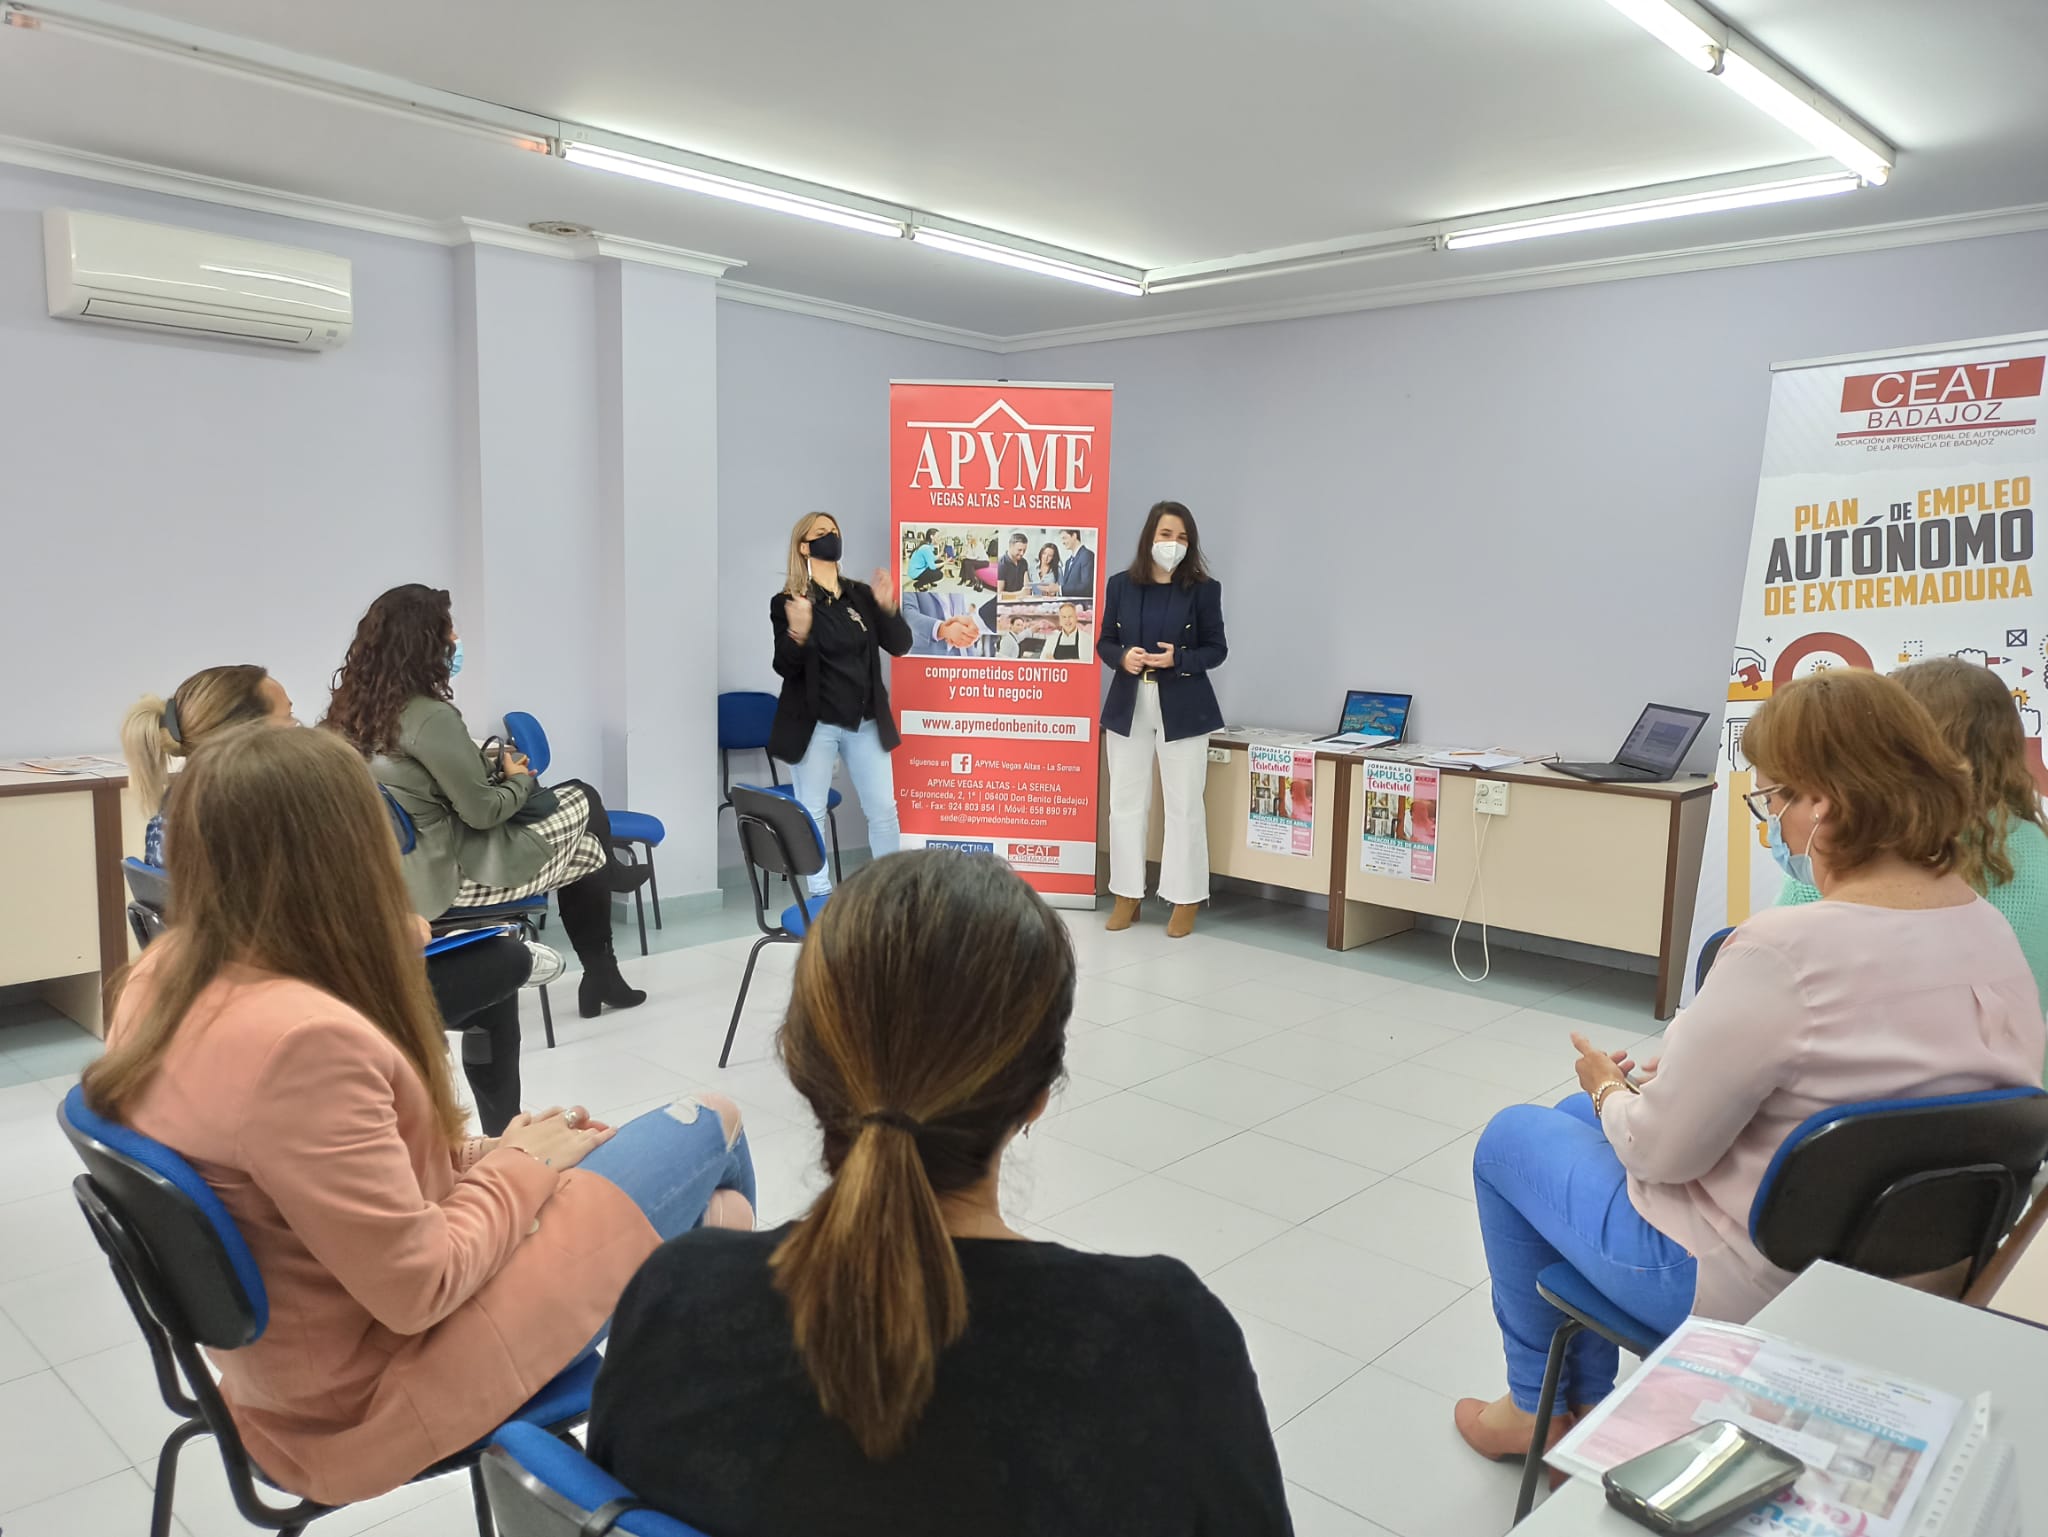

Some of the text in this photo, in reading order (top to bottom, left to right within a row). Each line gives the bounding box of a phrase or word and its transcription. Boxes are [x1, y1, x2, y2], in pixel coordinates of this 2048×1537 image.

[1871, 361, 2010, 408] CEAT
[1867, 401, 2003, 430] BADAJOZ
[1866, 437, 1996, 452] DE LA PROVINCIA DE BADAJOZ
[1958, 431, 1970, 440] DE
[909, 429, 1094, 494] APYME
[930, 491, 964, 508] VEGAS
[967, 492, 1000, 508] ALTAS
[1013, 494, 1026, 509] LA
[1029, 495, 1072, 510] SERENA
[1794, 475, 2031, 532] PLAN DE EMPLEO
[1764, 508, 2034, 585] AUTÓNOMO
[1764, 564, 2033, 617] DE EXTREMADURA
[925, 665, 1068, 683] comprometidos CONTIGO
[949, 683, 1043, 702] y con tu negocio
[921, 716, 1077, 736] www.apymedonbenito.com
[975, 759, 999, 769] APYME
[1001, 760, 1022, 771] Vegas
[1023, 761, 1041, 771] Altas
[1047, 763, 1055, 771] La
[1251, 751, 1292, 764] IMPULSO
[927, 778, 956, 788] APYME
[957, 779, 983, 789] VEGAS
[986, 780, 1010, 790] ALTAS
[1017, 782, 1028, 791] LA
[1029, 783, 1061, 792] SERENA
[1367, 769, 1413, 783] IMPULSO
[900, 788, 909, 798] C/
[984, 792, 1009, 801] 06400
[1010, 793, 1026, 802] Don
[1027, 794, 1052, 804] Benito
[1053, 795, 1089, 806] (Badajoz)
[948, 802, 963, 811] 924
[1015, 844, 1053, 857] CEAT
